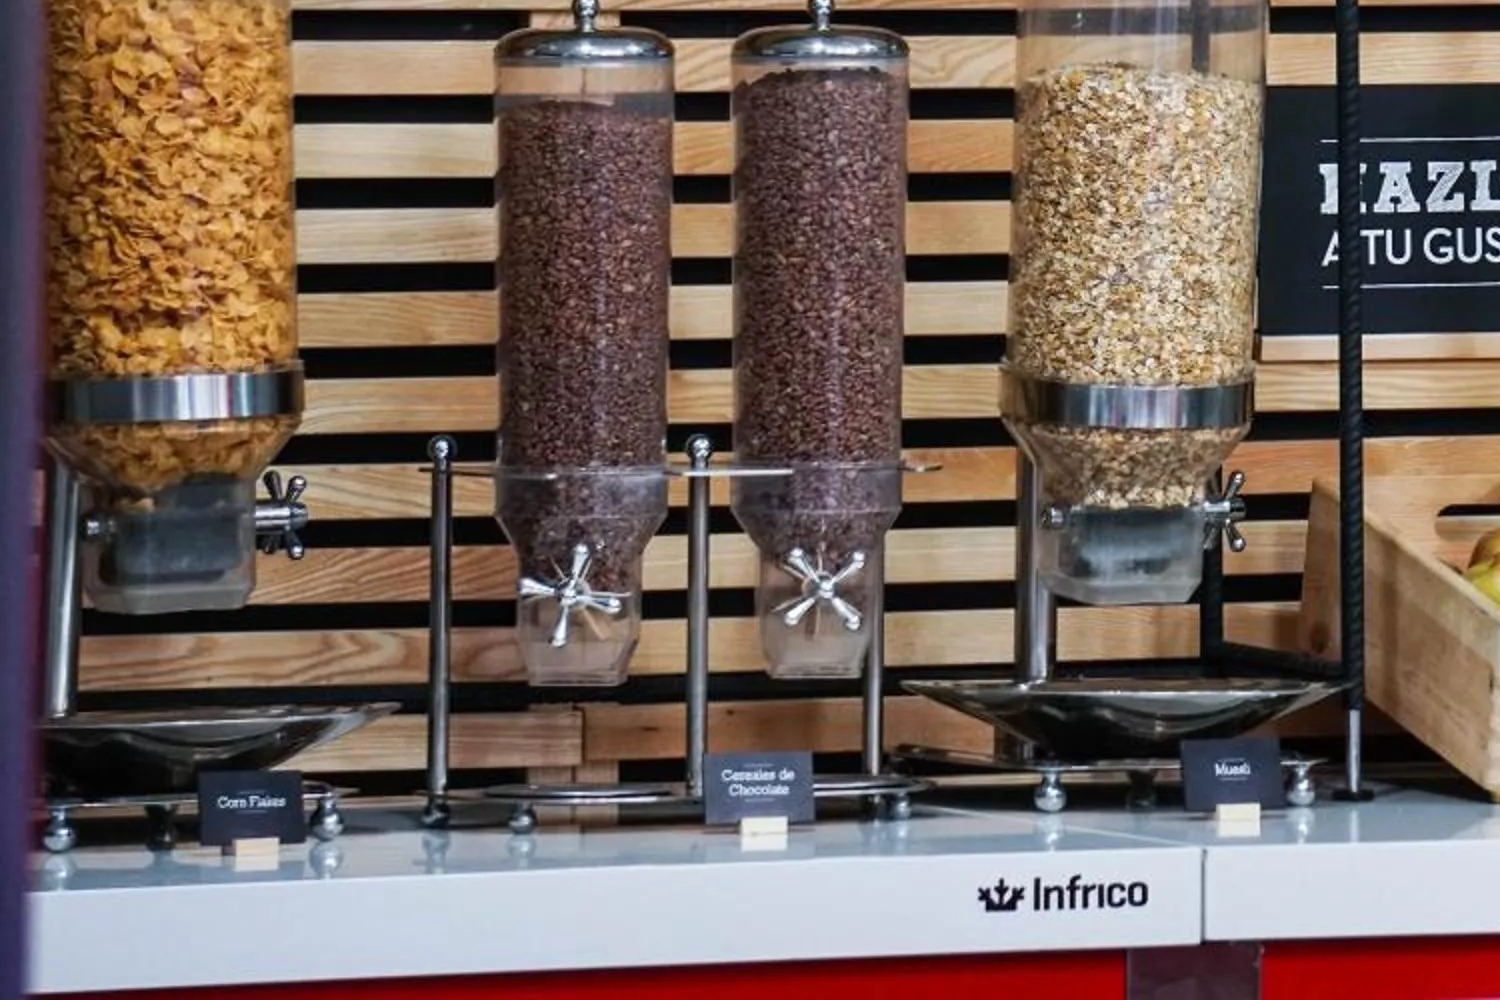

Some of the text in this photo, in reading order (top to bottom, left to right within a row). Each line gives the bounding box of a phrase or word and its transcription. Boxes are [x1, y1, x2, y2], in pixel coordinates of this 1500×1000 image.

[1360, 228, 1412, 265] TU
[721, 767, 796, 782] Cereales de
[728, 783, 790, 797] Chocolate
[217, 795, 247, 809] Corn
[1033, 874, 1149, 911] Infrico
